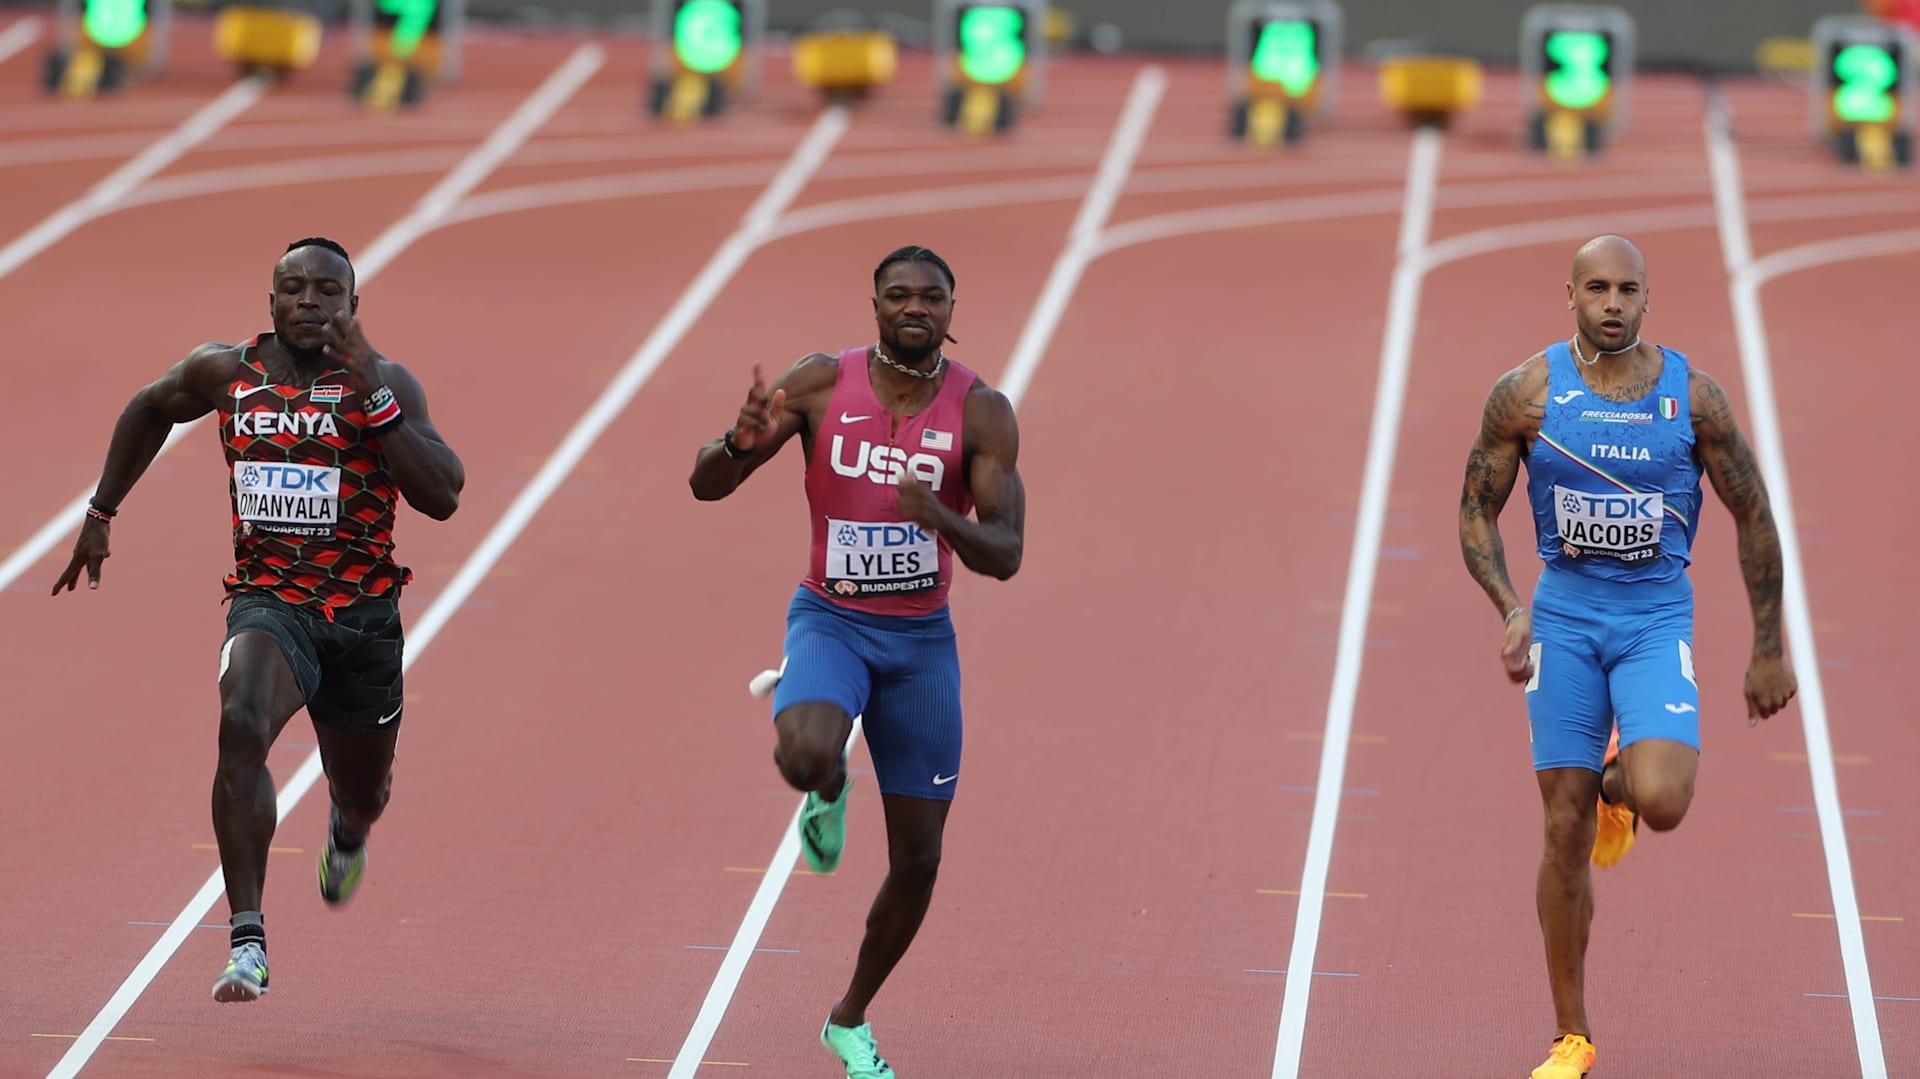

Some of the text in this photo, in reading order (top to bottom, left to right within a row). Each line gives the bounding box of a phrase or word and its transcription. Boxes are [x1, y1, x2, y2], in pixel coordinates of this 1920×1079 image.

[377, 0, 438, 57] 7
[674, 0, 743, 73] 6
[960, 6, 1026, 83] 5
[1252, 20, 1319, 97] 4
[1546, 32, 1609, 107] 3
[1834, 44, 1898, 122] 2
[234, 412, 339, 437] KENYA
[1580, 410, 1653, 421] FRECCIAROSSA
[830, 435, 945, 491] USA
[1591, 444, 1651, 461] ITALIA
[260, 466, 331, 492] TDK
[240, 493, 331, 519] OMANYALA
[1581, 496, 1654, 519] TDK
[317, 527, 331, 536] 23
[858, 524, 929, 547] TDK
[1562, 519, 1654, 546] JACOBS
[846, 551, 920, 577] LYLES
[1640, 548, 1654, 558] 23
[861, 578, 934, 593] BUDAPEST 23
